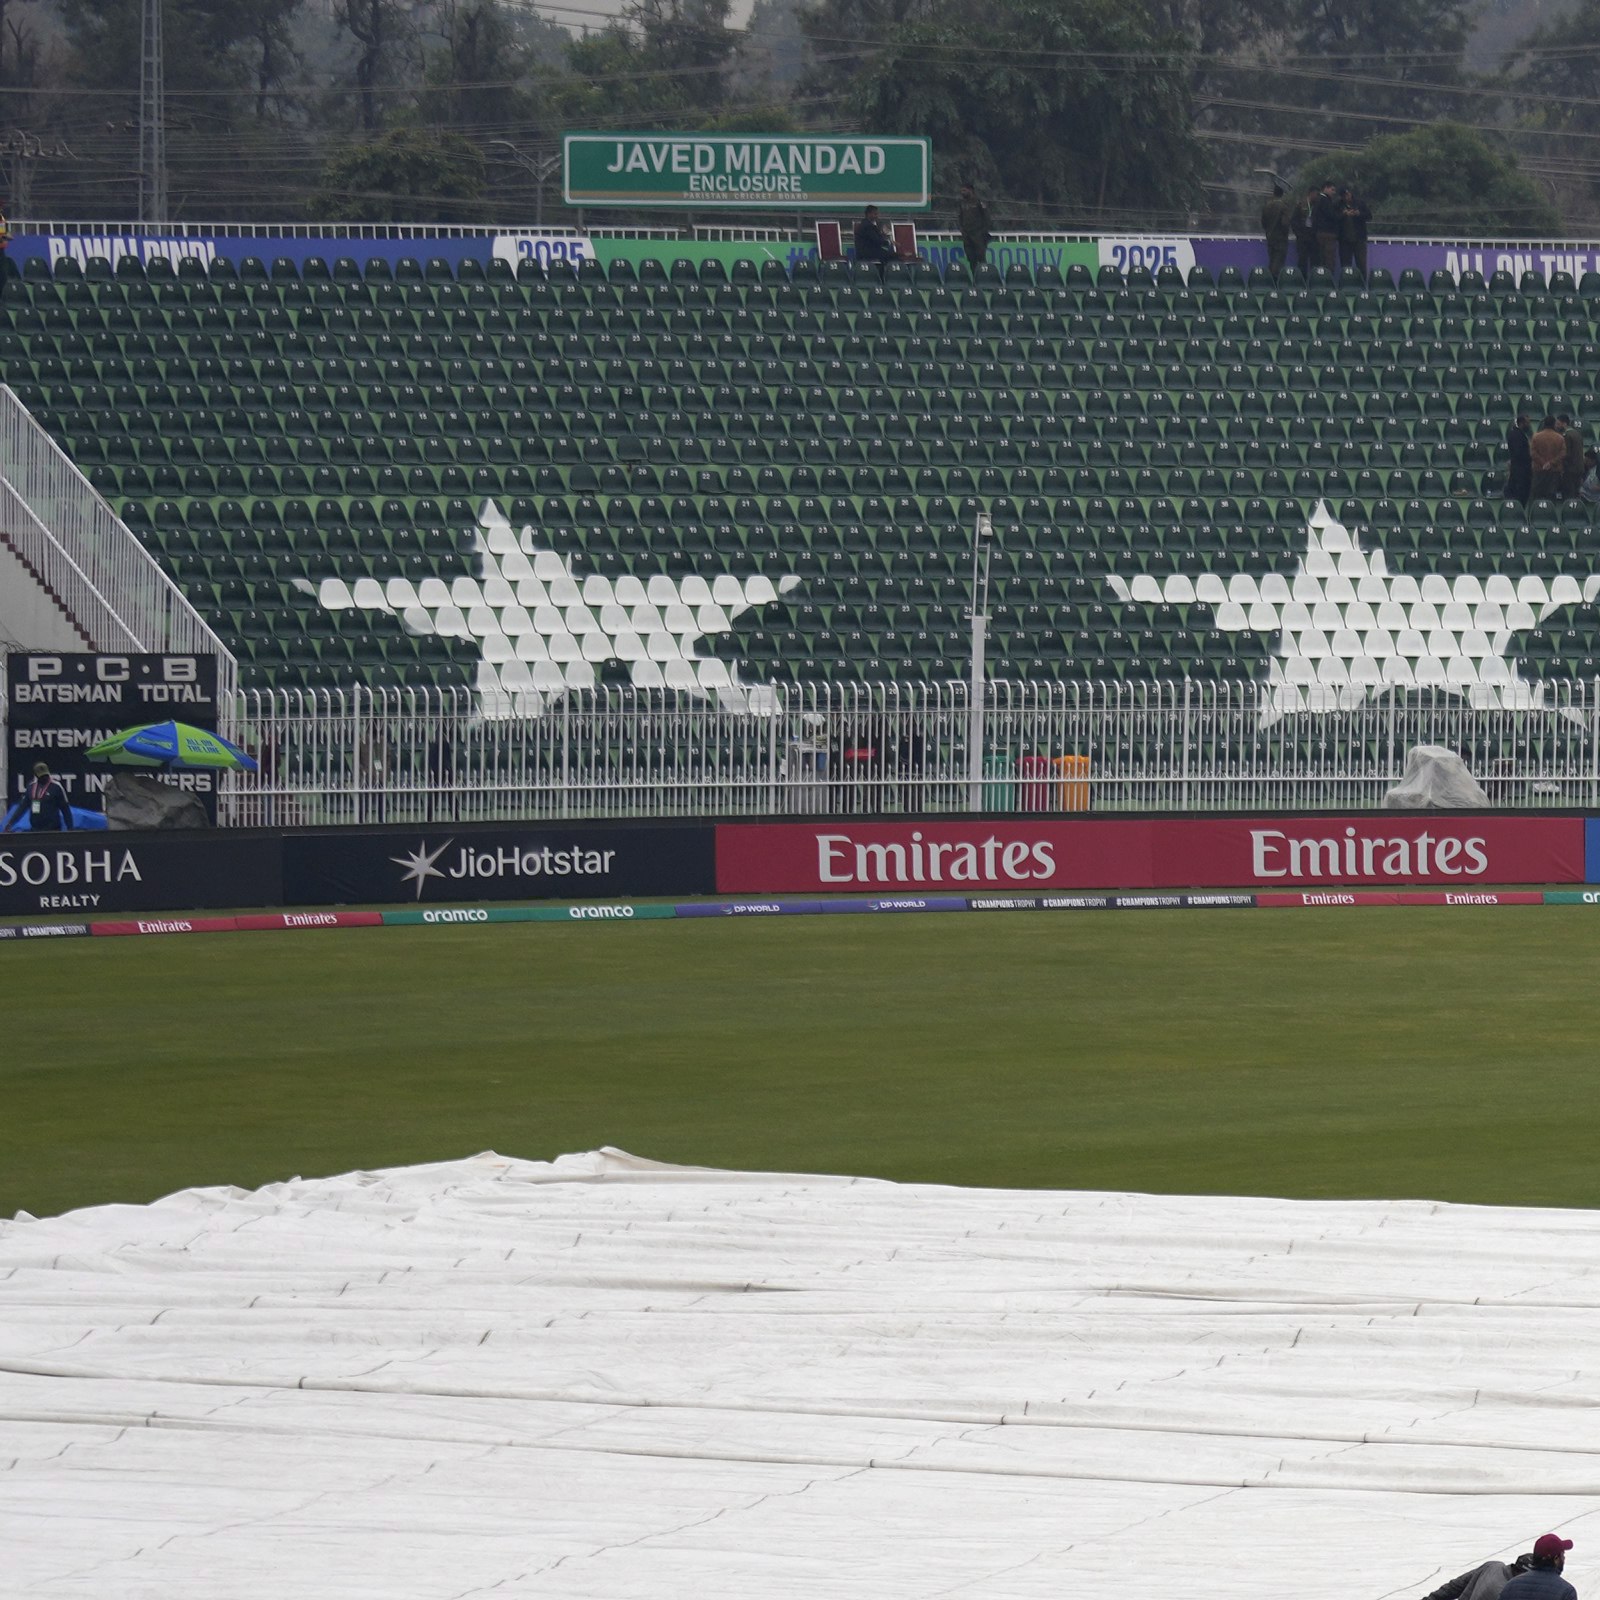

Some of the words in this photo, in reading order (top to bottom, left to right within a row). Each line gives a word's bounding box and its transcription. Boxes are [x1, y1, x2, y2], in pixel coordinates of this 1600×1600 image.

[607, 144, 715, 173] JAVED
[725, 144, 886, 175] MIANDAD
[689, 175, 802, 192] ENCLOSURE
[683, 191, 729, 200] PAKISTAN
[733, 191, 774, 200] CRICKET
[778, 192, 809, 200] BOARD
[14, 684, 123, 703] BATSMAN
[138, 684, 211, 703] TOTAL
[815, 832, 1056, 883] Emirates
[1249, 827, 1489, 878] Emirates
[0, 849, 142, 887] SOBHA
[449, 846, 616, 878] JioHotstar
[40, 894, 100, 908] REALTY
[1303, 892, 1354, 904] Emirates
[1446, 892, 1498, 904] Emirates
[570, 906, 633, 917] aramco
[749, 904, 780, 912] WORLD
[880, 901, 892, 909] DP
[284, 913, 337, 926] Emirates
[423, 909, 488, 922] aramco
[138, 921, 191, 933] Emirates
